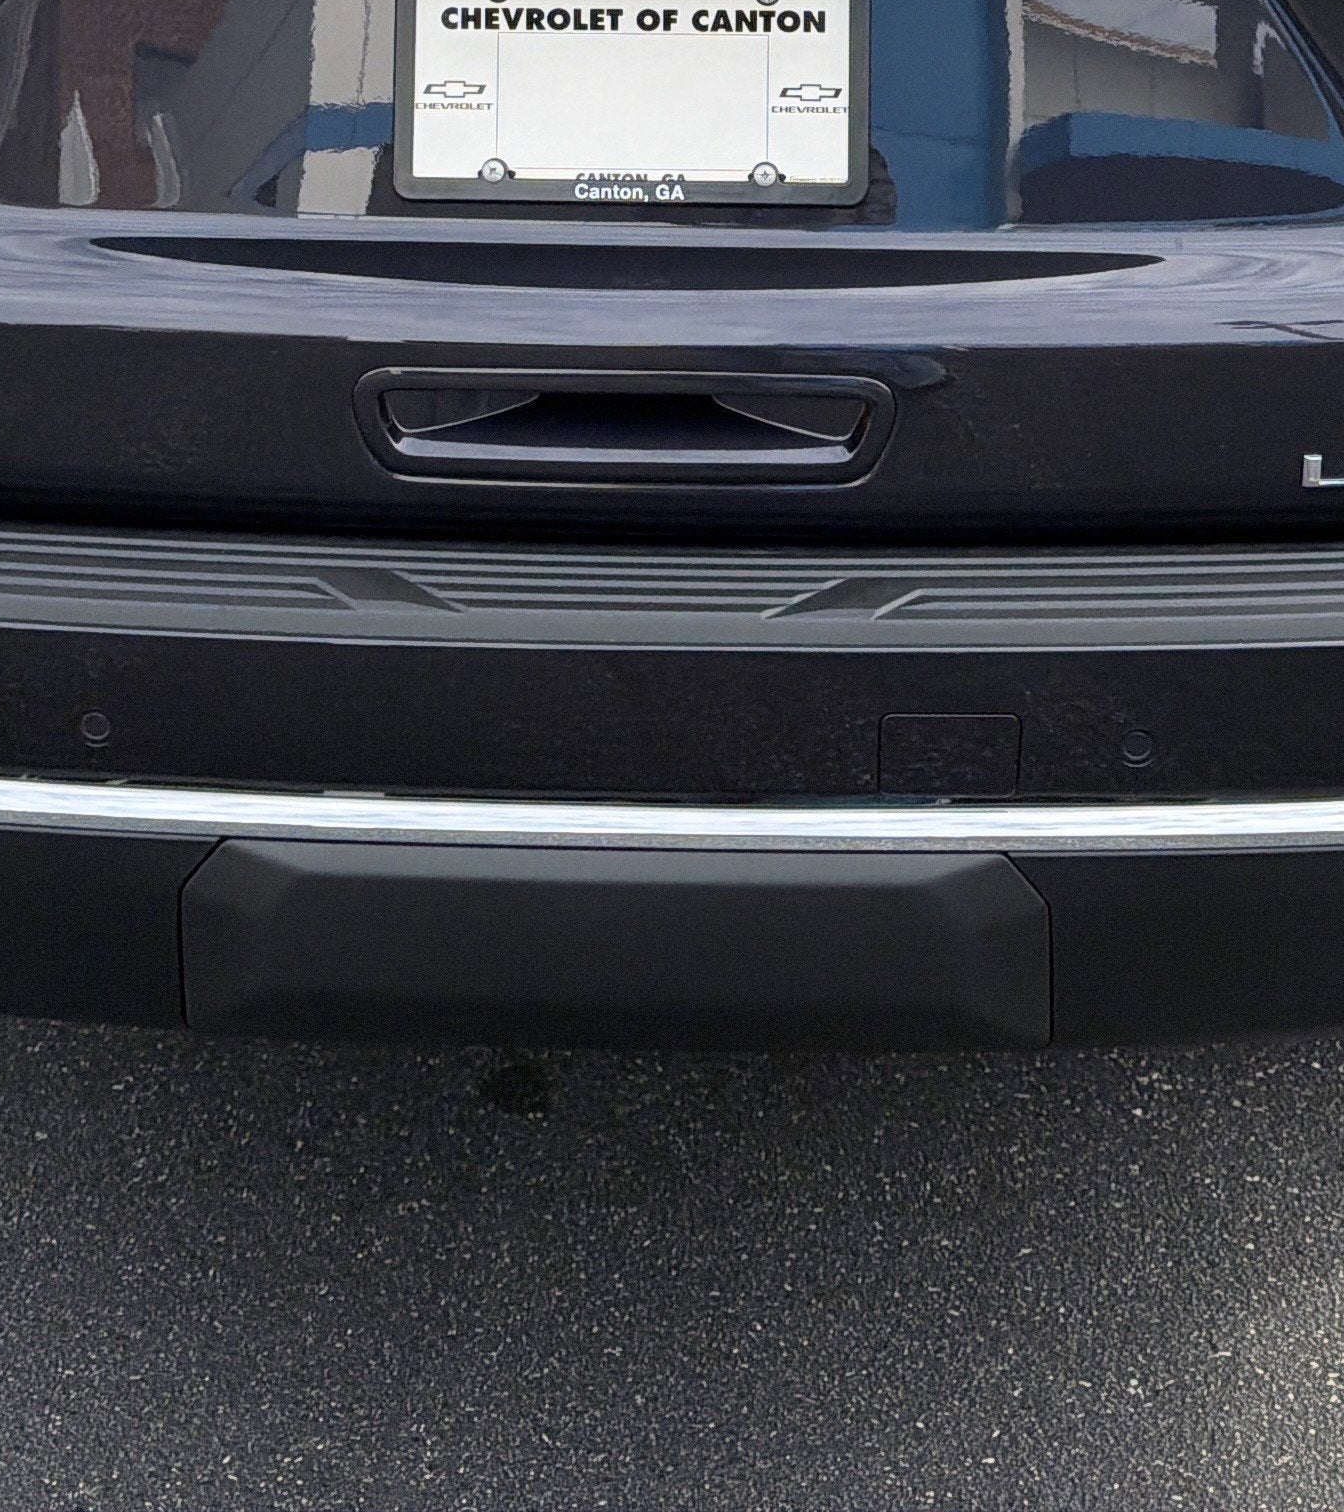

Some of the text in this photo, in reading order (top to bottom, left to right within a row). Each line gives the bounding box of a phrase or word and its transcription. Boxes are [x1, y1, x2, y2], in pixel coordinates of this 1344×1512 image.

[440, 6, 827, 34] CHEVROLET OF CANTON
[414, 101, 494, 111] CHEVROLET
[770, 105, 850, 114] CHEVROLET
[574, 182, 686, 203] Canton, GA
